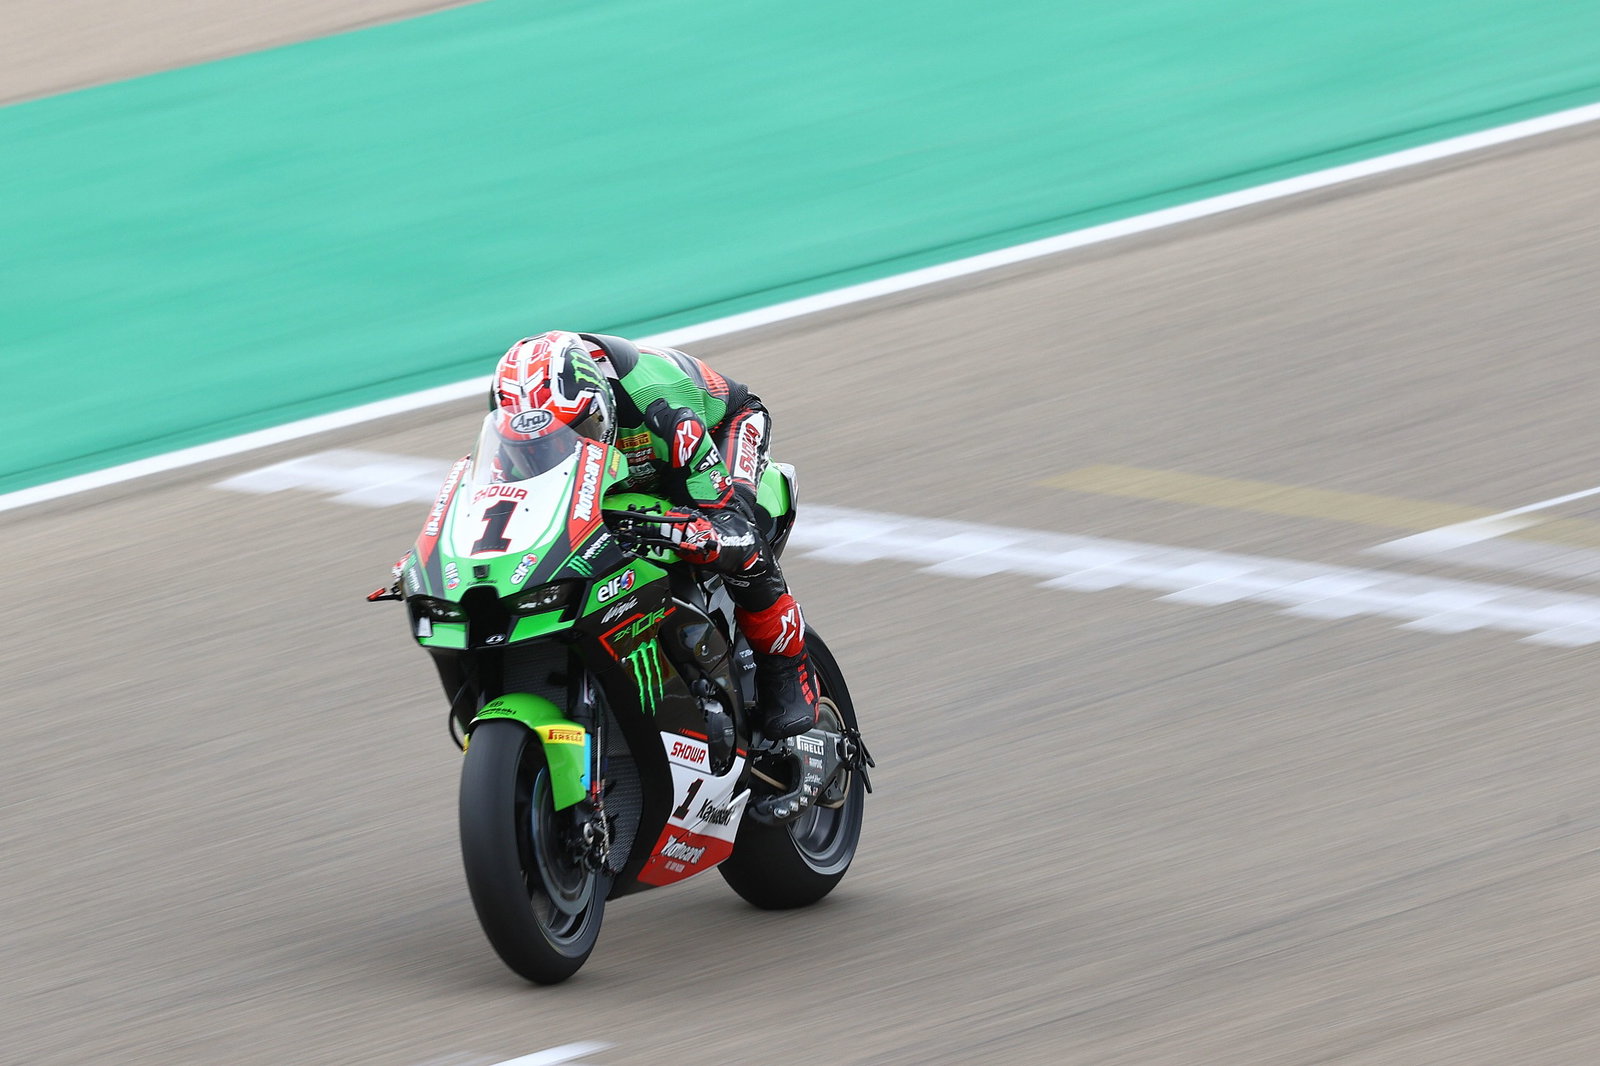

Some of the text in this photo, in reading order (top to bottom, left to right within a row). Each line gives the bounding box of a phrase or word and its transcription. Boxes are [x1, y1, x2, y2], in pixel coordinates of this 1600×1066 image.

[517, 411, 547, 427] Arai
[573, 443, 603, 521] Motocard
[473, 485, 528, 504] SHOWA
[470, 500, 518, 556] 1
[548, 729, 583, 742] PIRELLI
[796, 735, 825, 756] PIRELLI
[670, 741, 707, 765] SHOWA
[672, 778, 704, 820] 1
